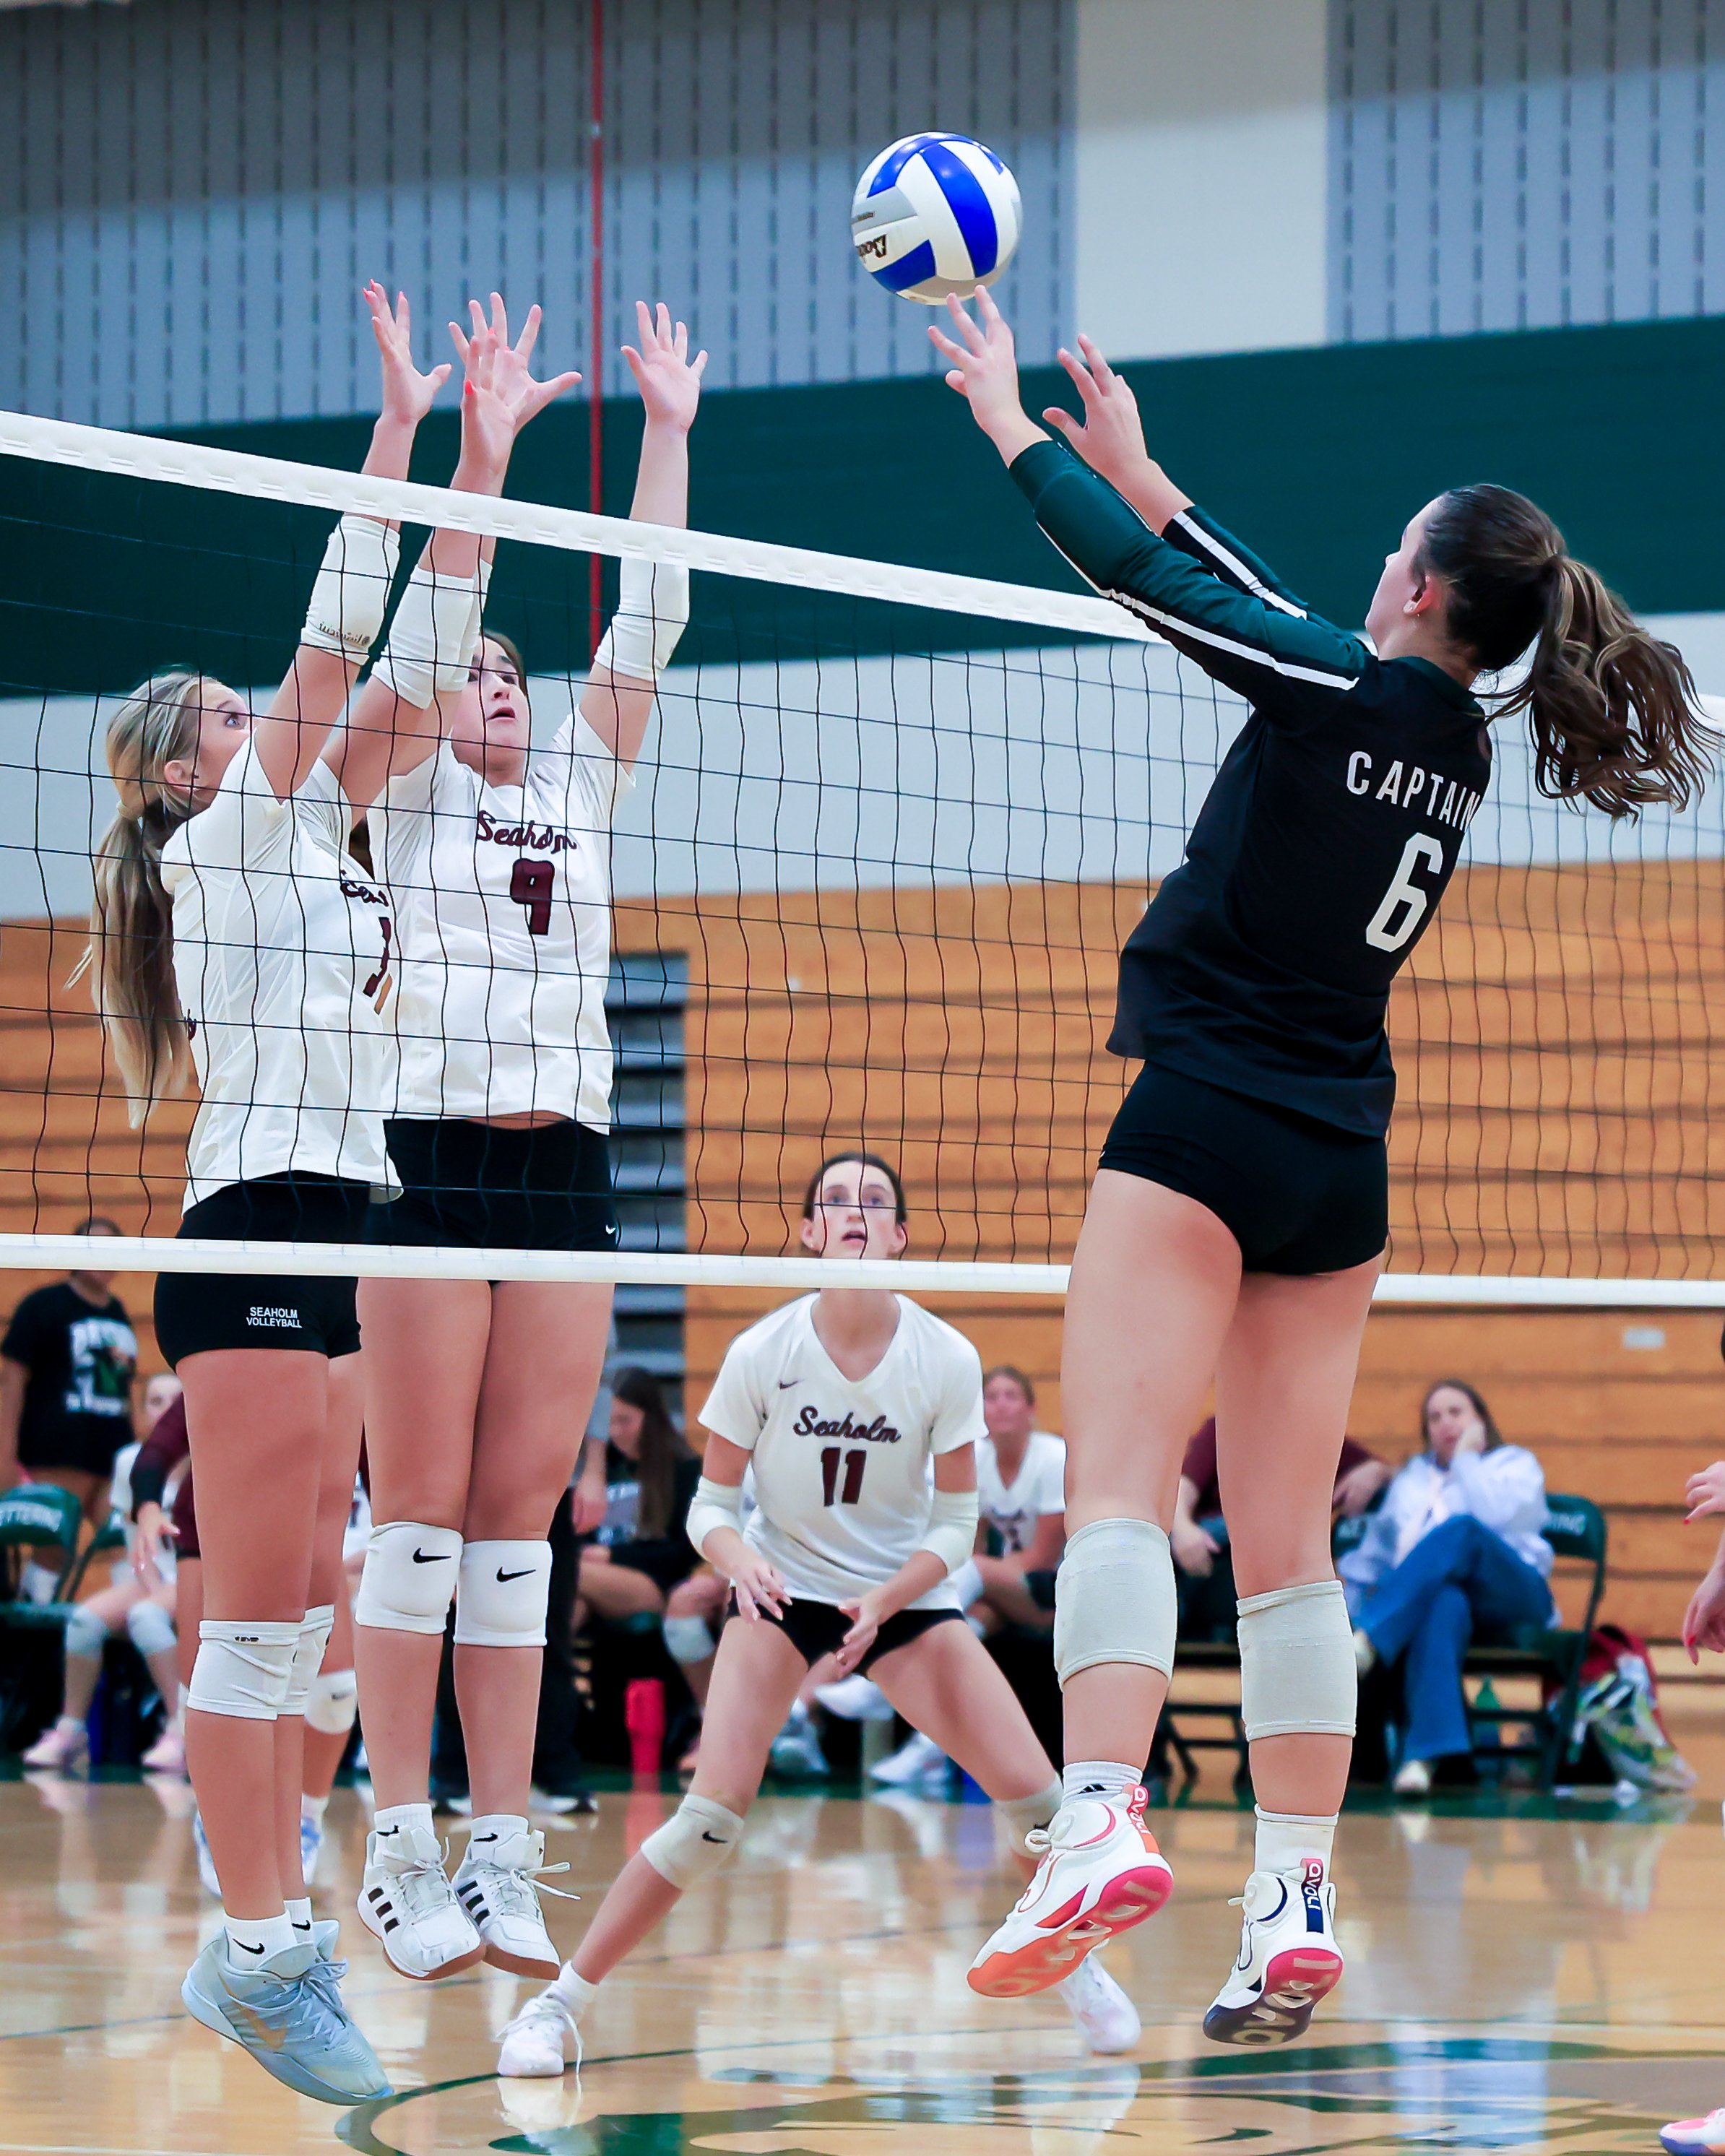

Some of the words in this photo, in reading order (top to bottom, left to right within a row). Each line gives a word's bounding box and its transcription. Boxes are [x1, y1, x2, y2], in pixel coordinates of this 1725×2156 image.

[1346, 751, 1480, 831] CAPTAIN
[509, 857, 555, 935] 9
[1366, 832, 1443, 953] 6
[246, 1317, 303, 1328] VOLLEYBALL
[249, 1306, 298, 1319] SEAHOLM
[792, 1405, 902, 1443] Seaholm
[821, 1446, 867, 1507] 11
